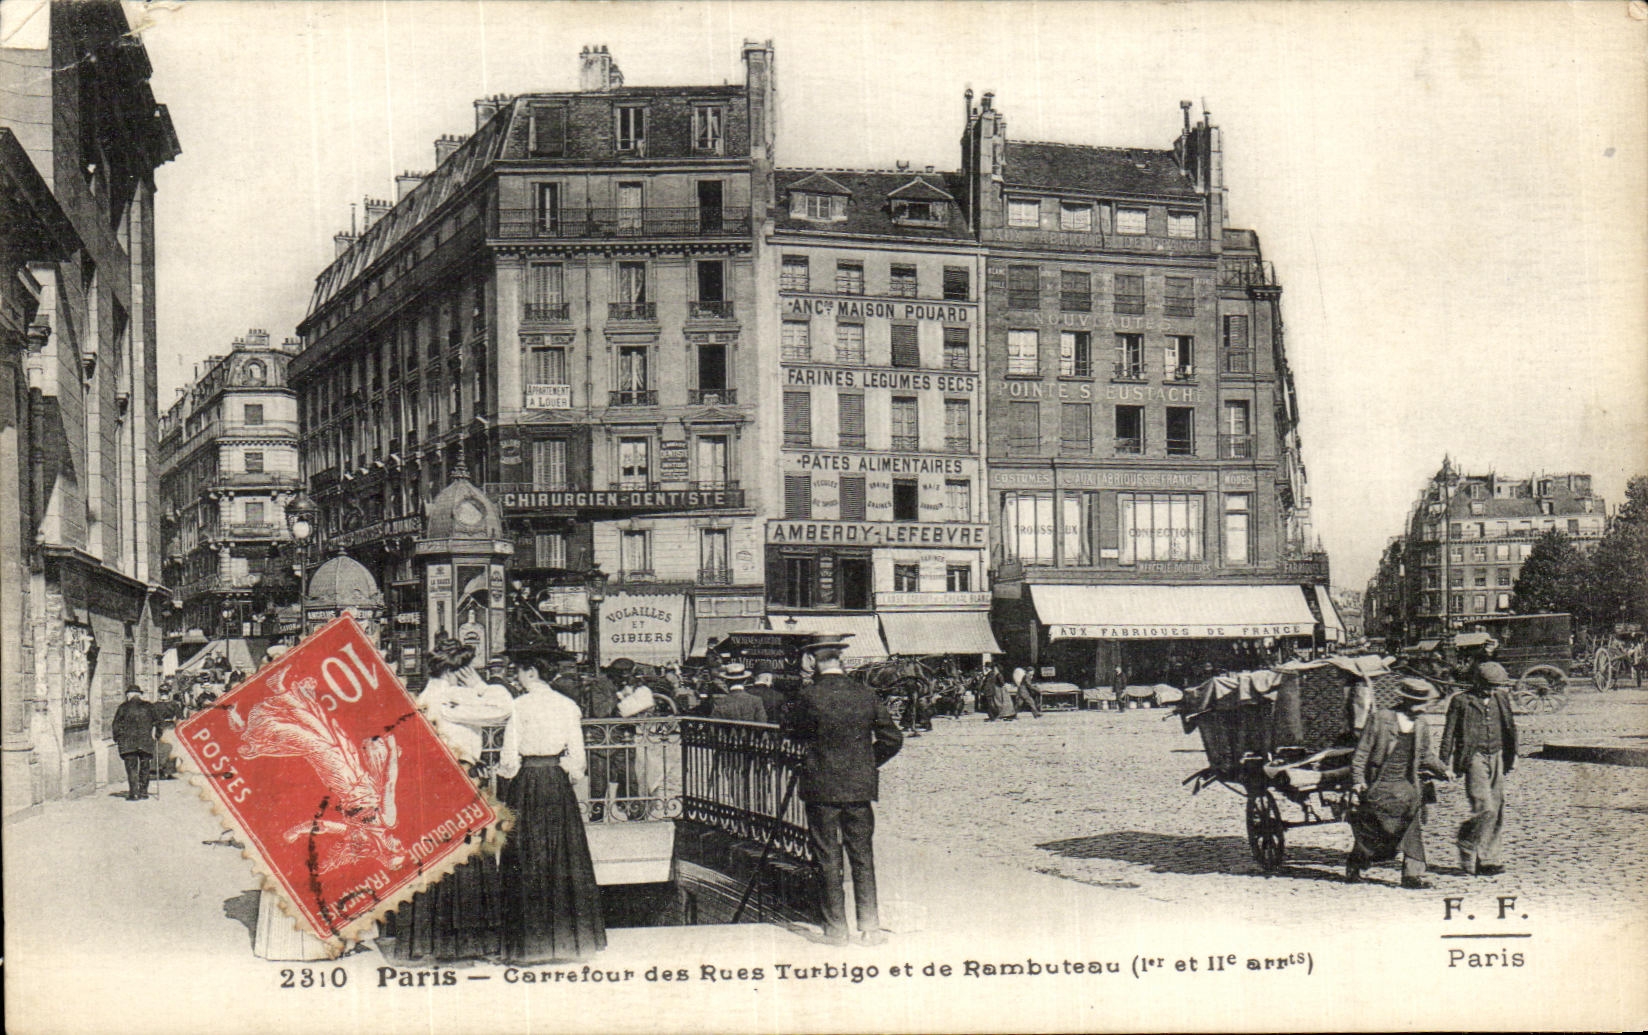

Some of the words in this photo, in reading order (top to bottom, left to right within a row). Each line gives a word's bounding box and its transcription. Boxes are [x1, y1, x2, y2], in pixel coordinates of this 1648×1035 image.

[838, 301, 895, 319] MAISON
[905, 306, 968, 321] POUARD
[937, 376, 974, 392] SECS
[998, 381, 1069, 398] POINTE
[539, 397, 568, 407] LOUER
[802, 455, 850, 471] PATES
[859, 457, 963, 474] ALIMENTAIRES
[993, 472, 1049, 485] COSTUMES
[605, 606, 672, 623] VOLAILLES
[632, 620, 645, 629] ET
[1060, 627, 1088, 636] AUX
[1101, 627, 1190, 637] FABRIQUES
[1207, 627, 1225, 636] DE
[1242, 625, 1301, 636] FRANCE
[611, 632, 673, 643] GIBIERS
[192, 727, 252, 804] POSTES
